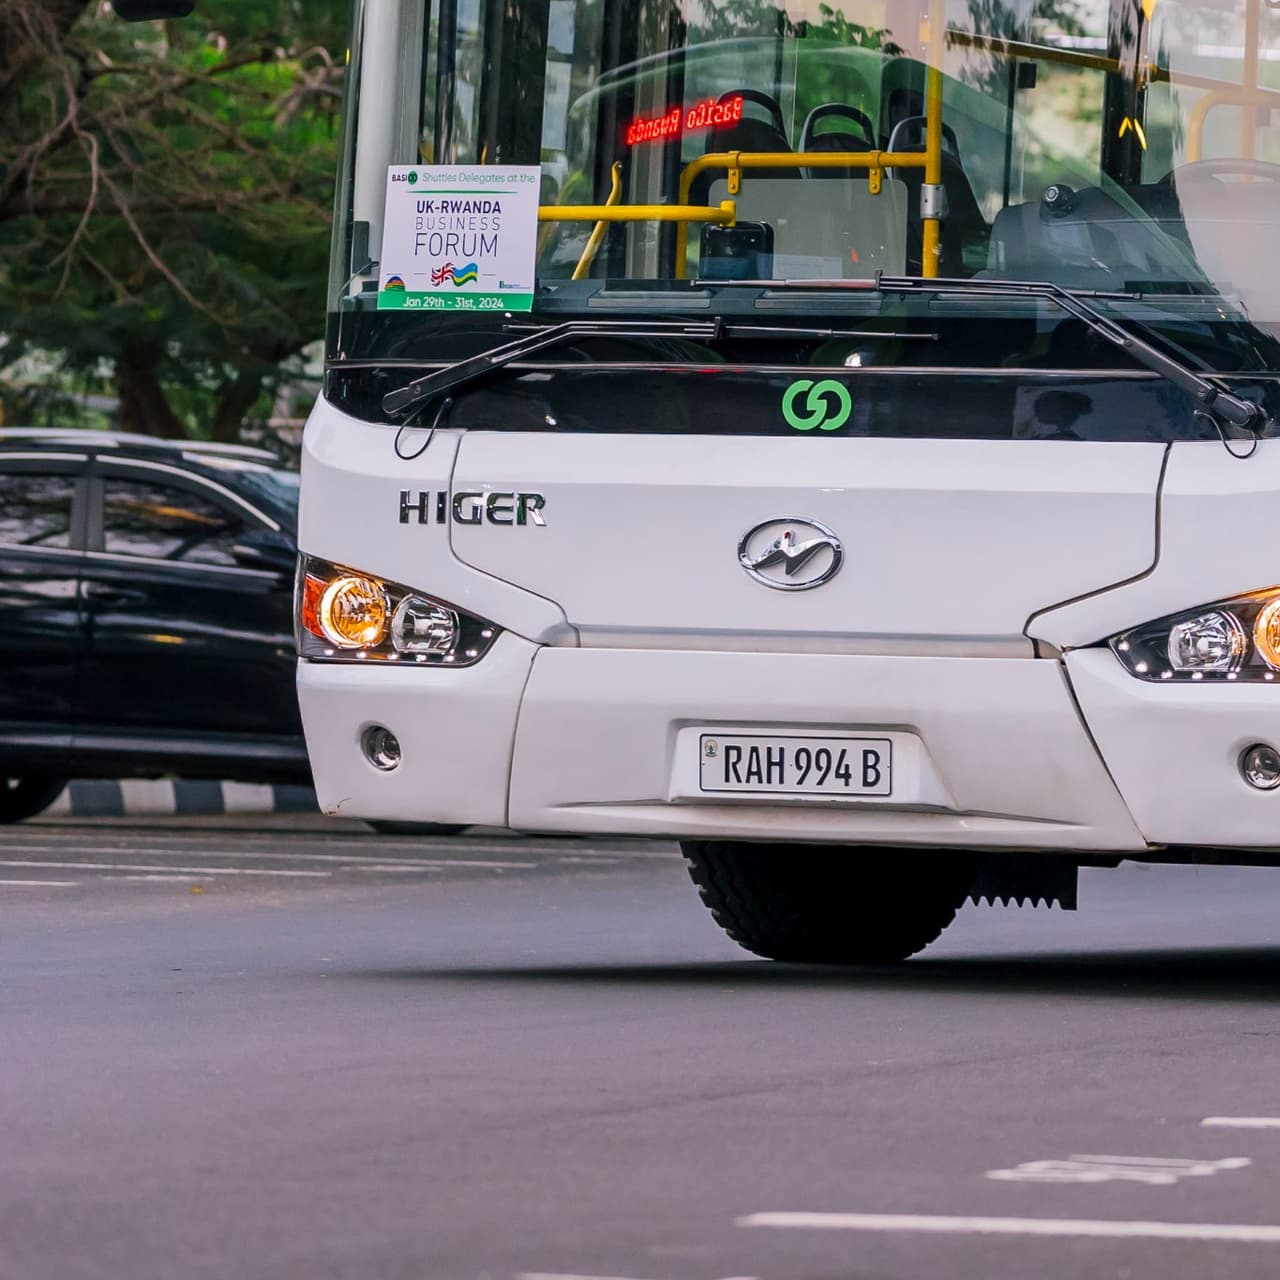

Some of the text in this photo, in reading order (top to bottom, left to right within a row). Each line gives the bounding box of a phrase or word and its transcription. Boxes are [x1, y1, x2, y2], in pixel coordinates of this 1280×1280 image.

[422, 172, 457, 183] Shuttles
[458, 173, 505, 185] Delegates
[507, 174, 519, 183] at
[520, 173, 536, 183] the
[416, 200, 502, 214] UK-RWANDA
[415, 216, 501, 231] BUSINESS
[414, 232, 499, 257] FORUM
[403, 296, 421, 308] Jan
[423, 296, 445, 308] 29th
[455, 297, 476, 310] 31st,
[479, 297, 504, 309] 2024
[400, 490, 547, 527] HIGER
[724, 744, 881, 787] RAH 994 B
